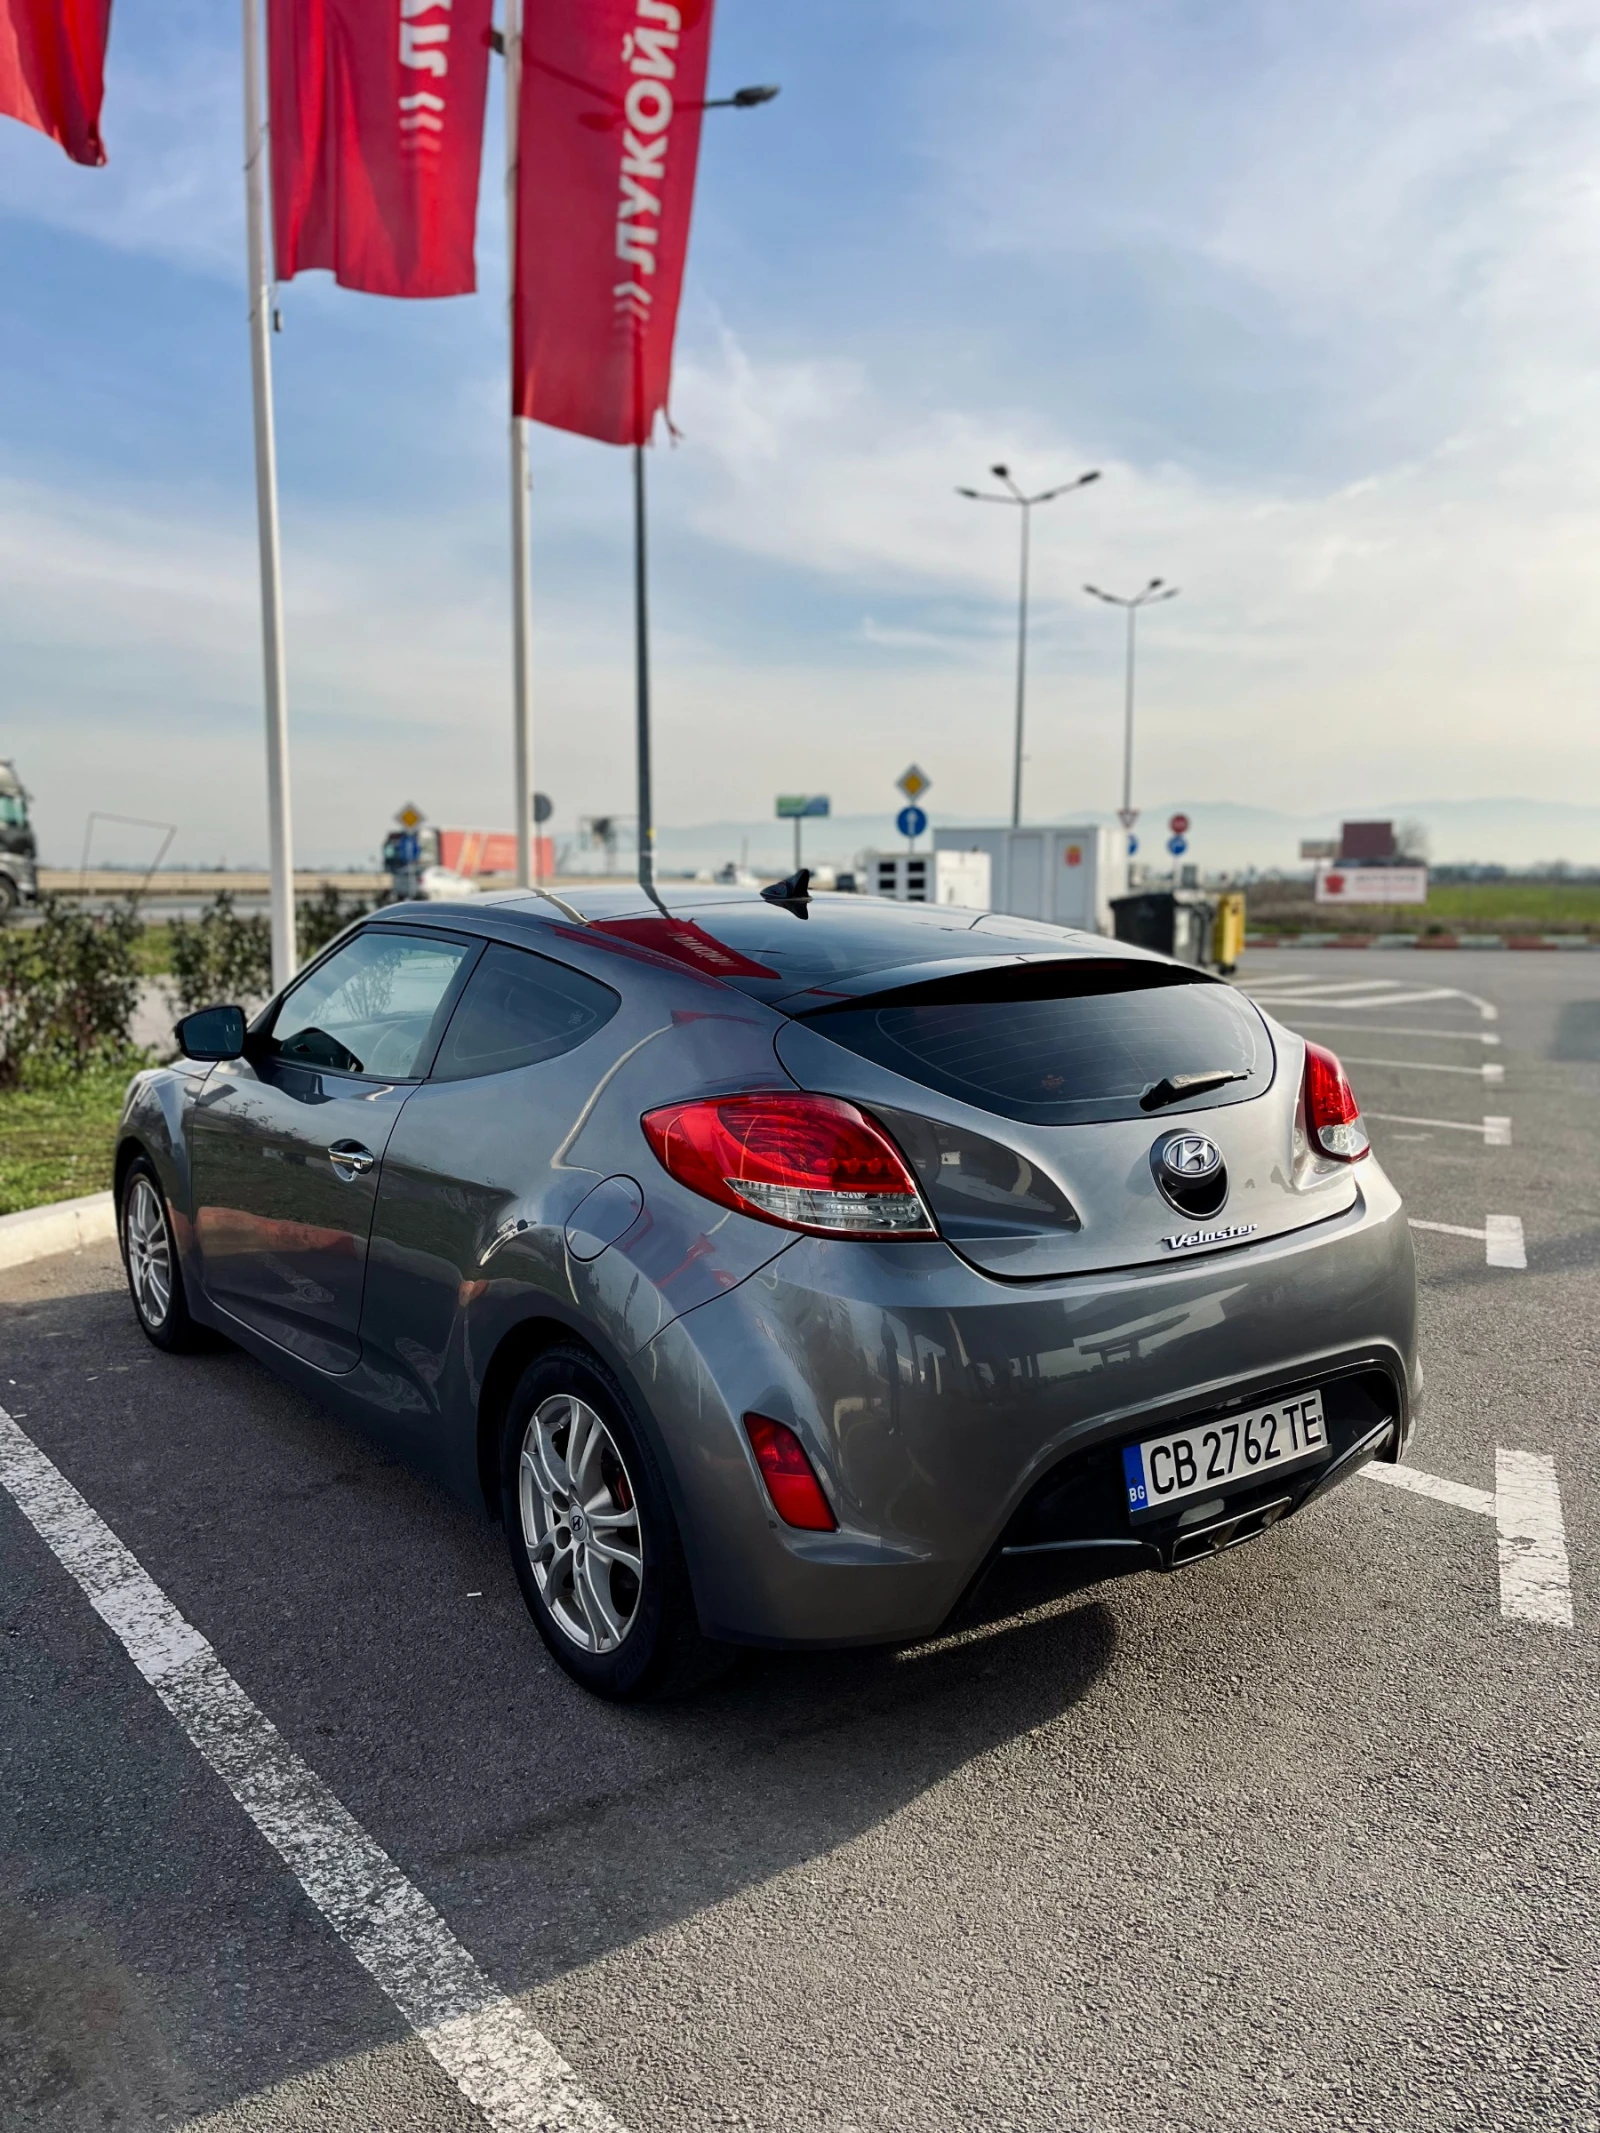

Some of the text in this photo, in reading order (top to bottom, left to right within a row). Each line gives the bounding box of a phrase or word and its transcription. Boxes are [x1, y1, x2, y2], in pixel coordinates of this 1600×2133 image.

[1163, 1223, 1258, 1249] Veloster
[1150, 1398, 1322, 1494] CB 2762 TE
[1128, 1485, 1146, 1503] BG
